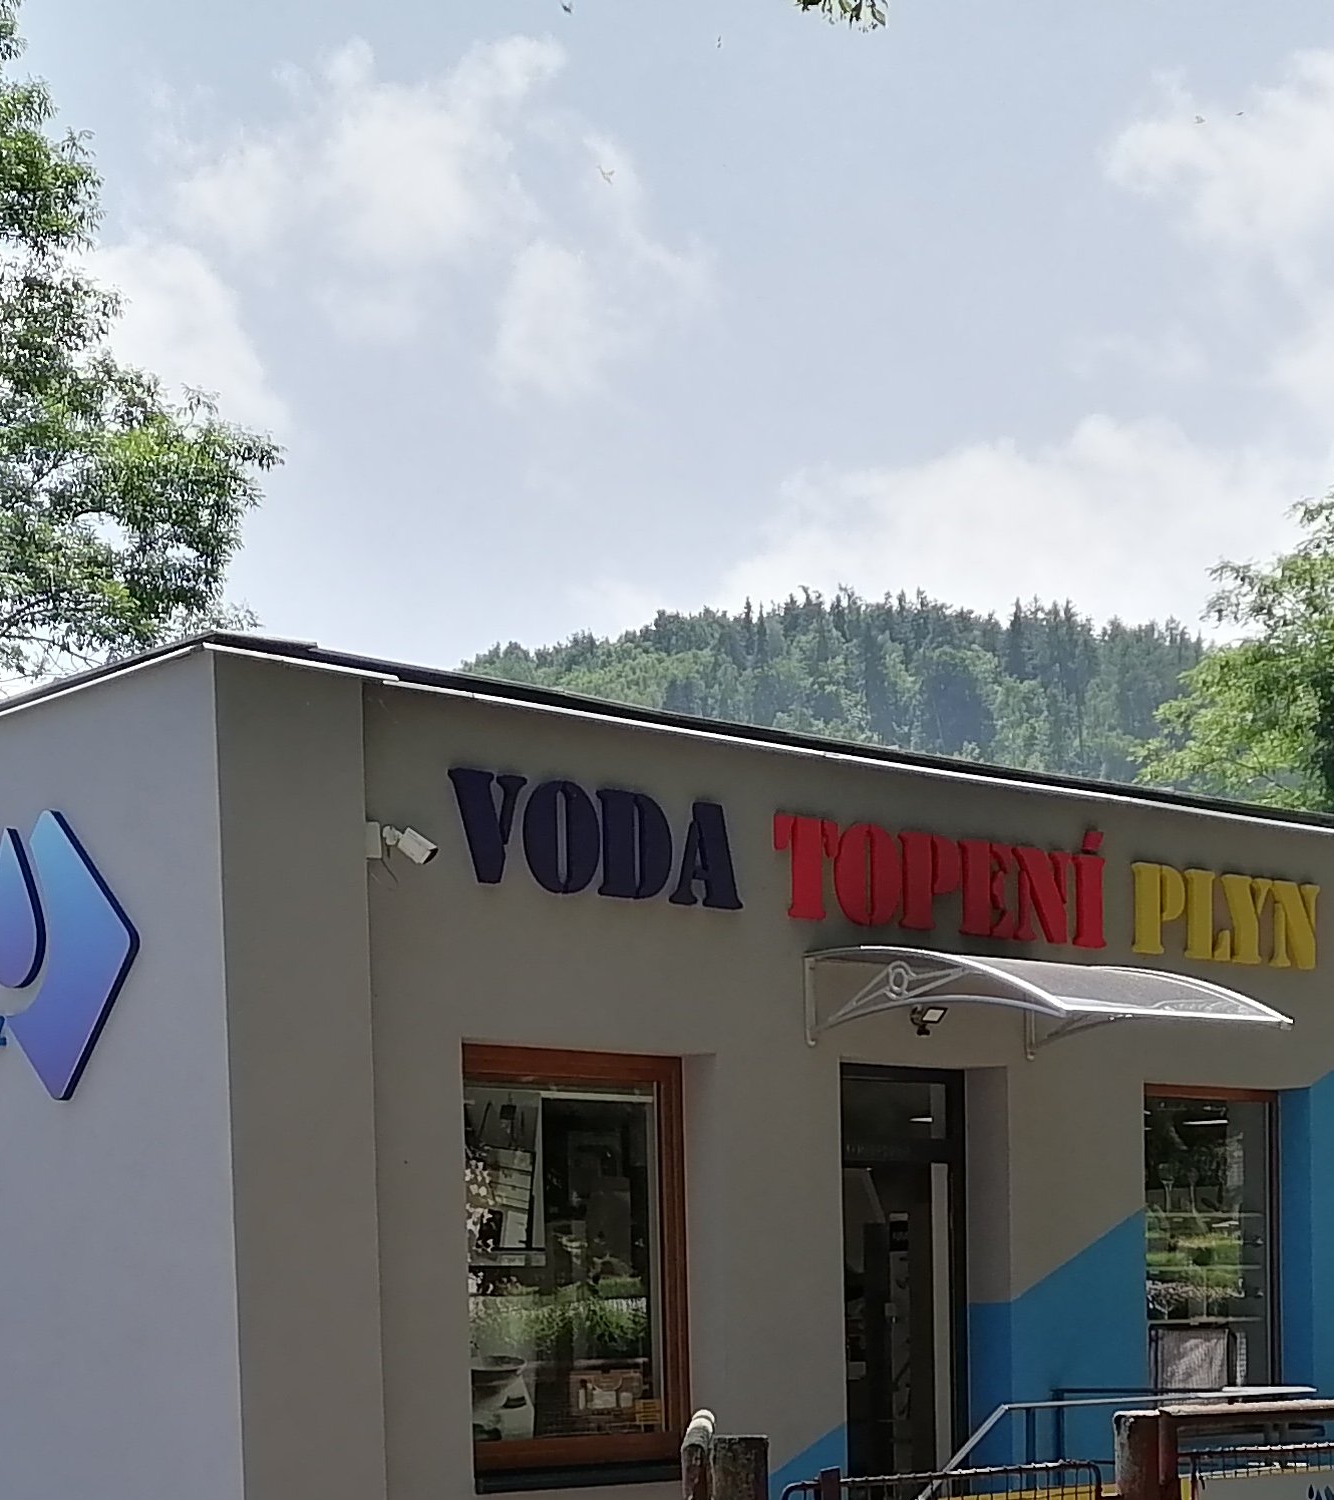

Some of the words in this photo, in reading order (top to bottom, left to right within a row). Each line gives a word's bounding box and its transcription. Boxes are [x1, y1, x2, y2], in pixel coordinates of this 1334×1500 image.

[448, 767, 743, 910] VODA
[774, 812, 1107, 949] TOPENÍ
[1131, 860, 1320, 970] PLYN
